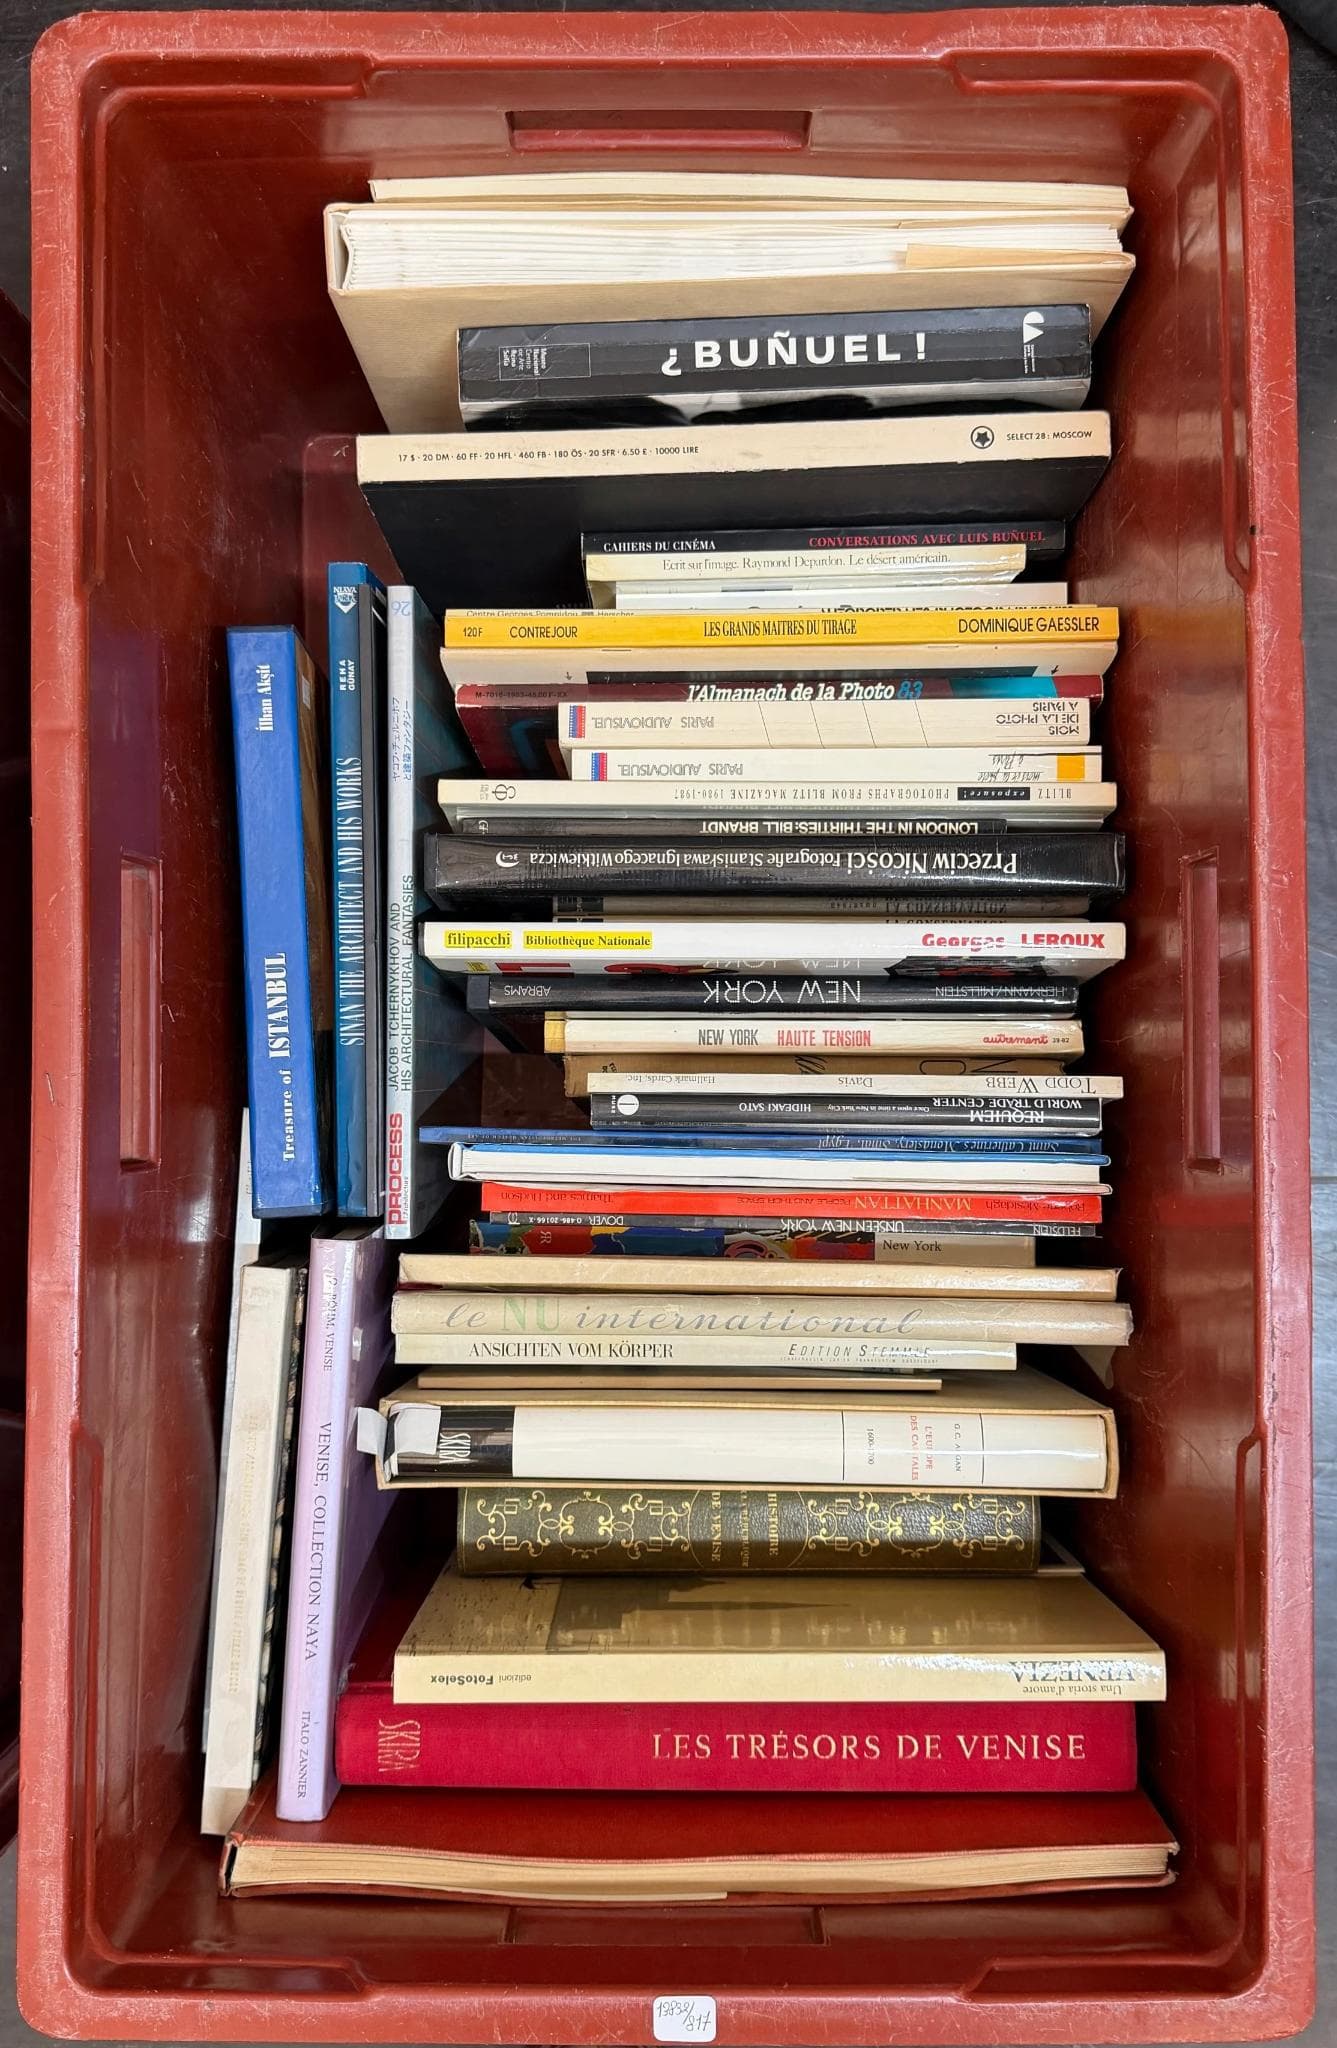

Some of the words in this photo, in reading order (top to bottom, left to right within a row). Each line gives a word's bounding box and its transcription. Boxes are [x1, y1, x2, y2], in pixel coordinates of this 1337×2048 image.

[1006, 432, 1034, 441] SELECT
[1052, 430, 1093, 440] MOSCOW
[398, 453, 408, 462] 17
[410, 453, 416, 462] $
[422, 452, 434, 462] 20
[435, 452, 450, 461] DM
[456, 451, 467, 461] 60
[469, 451, 478, 460] FF
[484, 450, 496, 460] 20
[497, 450, 513, 460] HFL
[518, 450, 535, 460] 460
[537, 449, 547, 459] FB
[553, 449, 569, 459] 180
[589, 448, 600, 458] 20
[601, 448, 616, 458] SFR
[622, 447, 639, 457] 6.50
[655, 446, 681, 456] 10000
[682, 445, 699, 455] LIRE
[603, 541, 652, 553] CAHIERS
[654, 541, 670, 551] DU
[672, 538, 716, 551] CINÉMA
[808, 533, 918, 547] CONVERSATIONS
[921, 532, 954, 545] AVEC
[958, 531, 989, 544] LUIS
[992, 528, 1045, 544] BUÑUEL
[742, 555, 791, 571] Raymond
[849, 553, 864, 566] Le
[391, 600, 412, 618] 26
[509, 625, 578, 639] CONTREJOUR
[703, 622, 720, 637] LES
[722, 621, 760, 637] GRANDS
[762, 620, 804, 636] MAITRES
[806, 620, 820, 635] DU
[822, 619, 857, 635] TIRAGE
[958, 617, 1034, 634] DOMINIQUE
[1035, 616, 1100, 633] GAESSLER
[338, 659, 347, 691] REHA
[346, 659, 356, 691] GÜNAY
[686, 684, 786, 702] l'Almanach
[789, 684, 811, 701] de
[814, 683, 836, 701] la
[838, 681, 895, 700] Photo
[897, 680, 924, 700] 83
[1032, 702, 1066, 712] PARIS
[591, 716, 674, 729] AUDIOVISUEL
[680, 716, 716, 729] PARIS
[995, 713, 1038, 725] PHOTO
[1042, 714, 1059, 724] LA
[1061, 714, 1080, 724] DE
[1048, 726, 1080, 736] MOIS
[617, 763, 702, 777] AUDIOVISUEL
[707, 763, 744, 777] PARIS
[335, 757, 363, 811] WORKS
[673, 788, 724, 799] 1980-1987
[729, 788, 786, 800] MAGAZINE
[793, 788, 826, 800] BLITZ
[831, 788, 862, 800] FROM
[867, 788, 950, 800] PHOTOGRAPHS
[1038, 788, 1072, 799] BLITZ
[335, 815, 363, 841] HIS
[699, 821, 759, 833] BRANDT
[762, 821, 793, 833] BILL
[792, 821, 857, 834] THIRTIES:
[859, 821, 894, 834] THE
[897, 821, 913, 834] IN
[915, 821, 979, 834] LONDON
[336, 846, 364, 876] AND
[529, 852, 613, 868] Witkiewicza
[614, 849, 681, 868] Ignacego
[683, 852, 763, 868] Stanisława
[768, 849, 841, 867] Fotografie
[847, 852, 927, 875] Nicości
[931, 852, 1018, 874] Przeciw
[388, 902, 401, 932] AND
[401, 874, 414, 946] FANTASIES
[337, 880, 365, 964] ARCHITECT
[447, 932, 511, 948] filipacchi
[525, 935, 595, 949] Bibliothèque
[598, 934, 651, 947] Nationale
[1020, 933, 1105, 948] LEROUX
[337, 969, 365, 999] THE
[388, 936, 400, 1041] TCHERNYKHOV
[503, 984, 551, 997] ABRAMS
[703, 979, 784, 1004] YORK
[797, 979, 862, 1004] NEW
[263, 952, 291, 1059] ISTANBUL
[401, 953, 414, 1065] ARCHITECTURAL
[337, 1003, 366, 1046] SINAN
[698, 1029, 724, 1046] NEW
[730, 1029, 759, 1046] YORK
[777, 1030, 817, 1047] HAUTE
[822, 1030, 872, 1047] TENSION
[982, 1033, 1049, 1045] autrement
[277, 1069, 293, 1085] of
[387, 1047, 400, 1093] JACOB
[400, 1069, 413, 1092] HIS
[674, 1074, 717, 1085] Hallmark
[838, 1076, 874, 1089] Davis
[739, 1102, 765, 1112] SATO
[768, 1103, 812, 1112] HIDEAKI
[932, 1097, 992, 1109] CENTER
[995, 1097, 1033, 1109] TRADE
[1033, 1099, 1083, 1110] WORLD
[970, 1107, 1045, 1124] REQUIEM
[281, 1090, 297, 1162] Treasure
[963, 1140, 1025, 1153] Catherine's
[1028, 1140, 1059, 1153] Saint
[387, 1112, 408, 1225] PROCESS
[854, 1196, 972, 1212] MANHATTAN
[588, 1215, 625, 1226] DOVER
[780, 1219, 819, 1233] YORK
[821, 1220, 853, 1233] NEW
[856, 1220, 906, 1233] UNSEEN
[1033, 1225, 1081, 1237] FELDSTEIN
[882, 1240, 910, 1252] New
[912, 1240, 942, 1252] York
[445, 1305, 488, 1329] le
[499, 1296, 563, 1333] NU
[576, 1304, 925, 1336] international
[322, 1332, 336, 1373] VENISE
[468, 1342, 563, 1359] ANSICHTEN
[566, 1342, 604, 1359] VOM
[608, 1338, 673, 1359] KÖRPER
[788, 1343, 853, 1357] EDITION
[909, 1415, 918, 1431] DES
[312, 1421, 333, 1488] VENISE,
[440, 1432, 472, 1465] SKIRA
[954, 1443, 963, 1472] AGAN
[711, 1491, 722, 1510] DE
[767, 1492, 779, 1556] HISTOIRE
[710, 1513, 722, 1562] VENISE
[308, 1494, 328, 1607] COLLECTION
[304, 1612, 321, 1661] NAYA
[430, 1675, 495, 1686] FotoSelex
[498, 1674, 533, 1684] edizioni
[1022, 1685, 1066, 1696] d'amore
[1067, 1685, 1097, 1696] storia
[1099, 1685, 1122, 1696] Una
[299, 1710, 312, 1746] ITALO
[378, 1718, 421, 1773] SKIRA
[652, 1733, 712, 1760] LES
[725, 1730, 881, 1760] TRÉSORS
[897, 1733, 943, 1760] DE
[955, 1733, 1087, 1761] VENISE
[296, 1747, 310, 1799] ZANNIER
